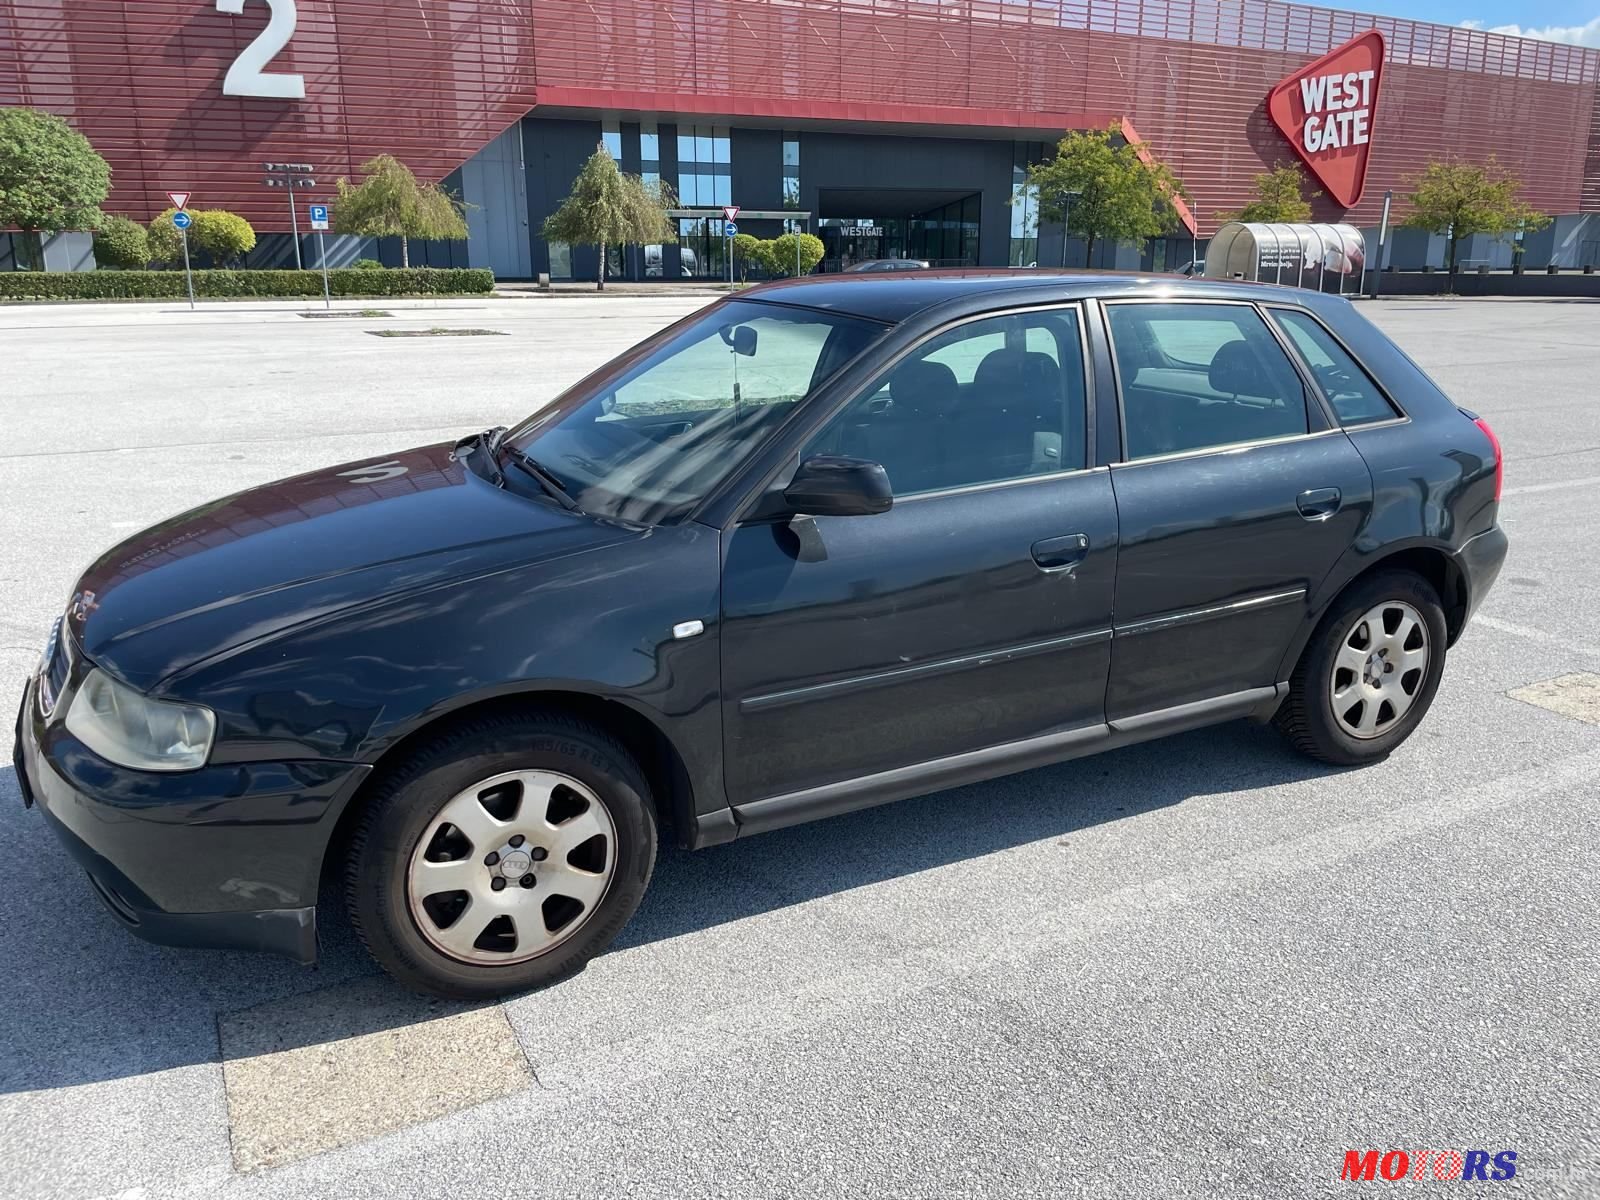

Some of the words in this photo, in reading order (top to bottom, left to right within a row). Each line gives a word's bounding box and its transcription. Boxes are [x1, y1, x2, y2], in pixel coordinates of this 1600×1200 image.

[216, 0, 306, 98] 2
[1300, 70, 1375, 114] WEST
[1303, 109, 1369, 153] GATE
[314, 209, 323, 219] P
[840, 226, 883, 237] WESTGATE
